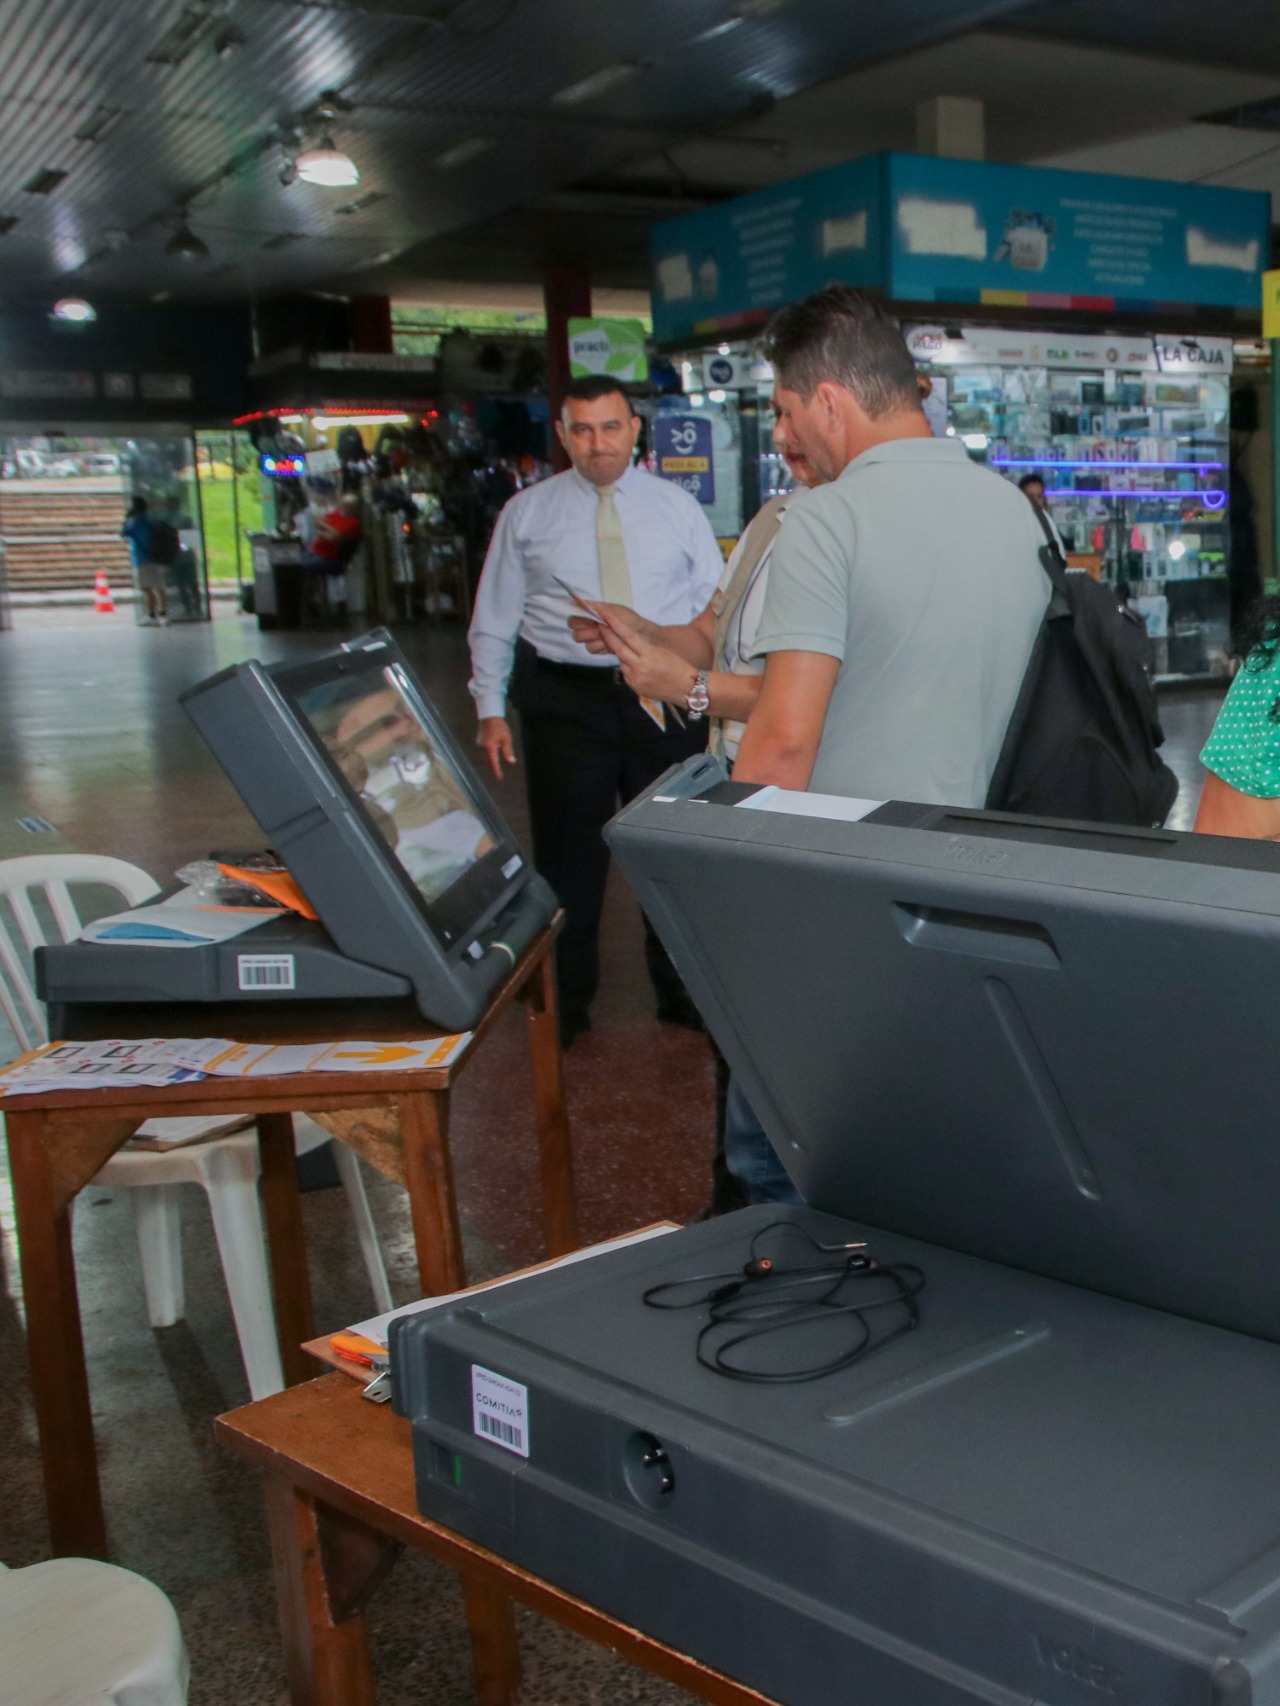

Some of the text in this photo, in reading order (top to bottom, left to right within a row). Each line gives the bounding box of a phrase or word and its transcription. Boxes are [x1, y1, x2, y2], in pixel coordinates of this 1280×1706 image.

[1164, 346, 1182, 362] LA
[1187, 347, 1225, 364] CAJA
[475, 1392, 516, 1417] COMITIA
